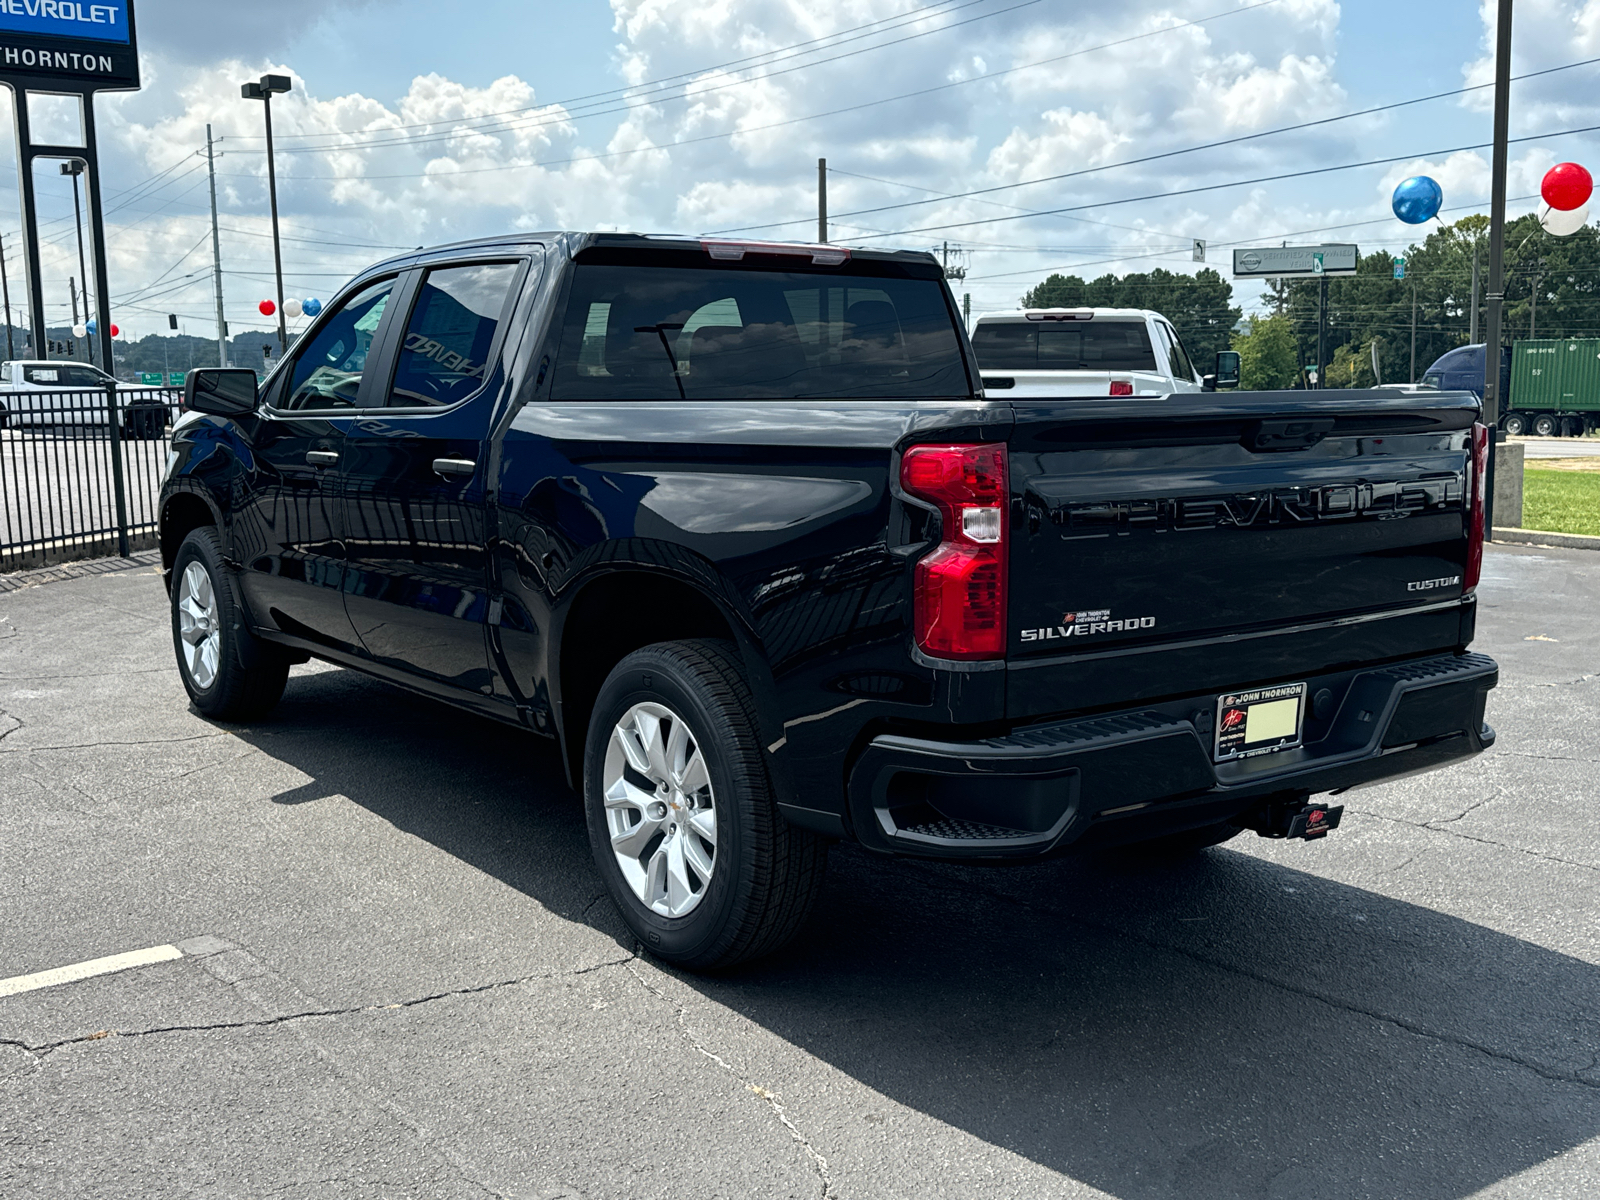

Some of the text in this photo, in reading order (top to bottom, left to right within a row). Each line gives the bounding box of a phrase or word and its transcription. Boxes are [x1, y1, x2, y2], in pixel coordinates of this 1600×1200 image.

[0, 46, 113, 73] HORNTON
[1263, 251, 1304, 261] CERTIFIED
[1315, 262, 1320, 270] 6
[1061, 476, 1461, 540] CHEVROLET
[1407, 575, 1460, 591] CUSTOM
[1021, 616, 1156, 642] SILVERADO
[1239, 685, 1302, 703] JOHN THORNTON
[1247, 748, 1272, 758] CHEVROLET
